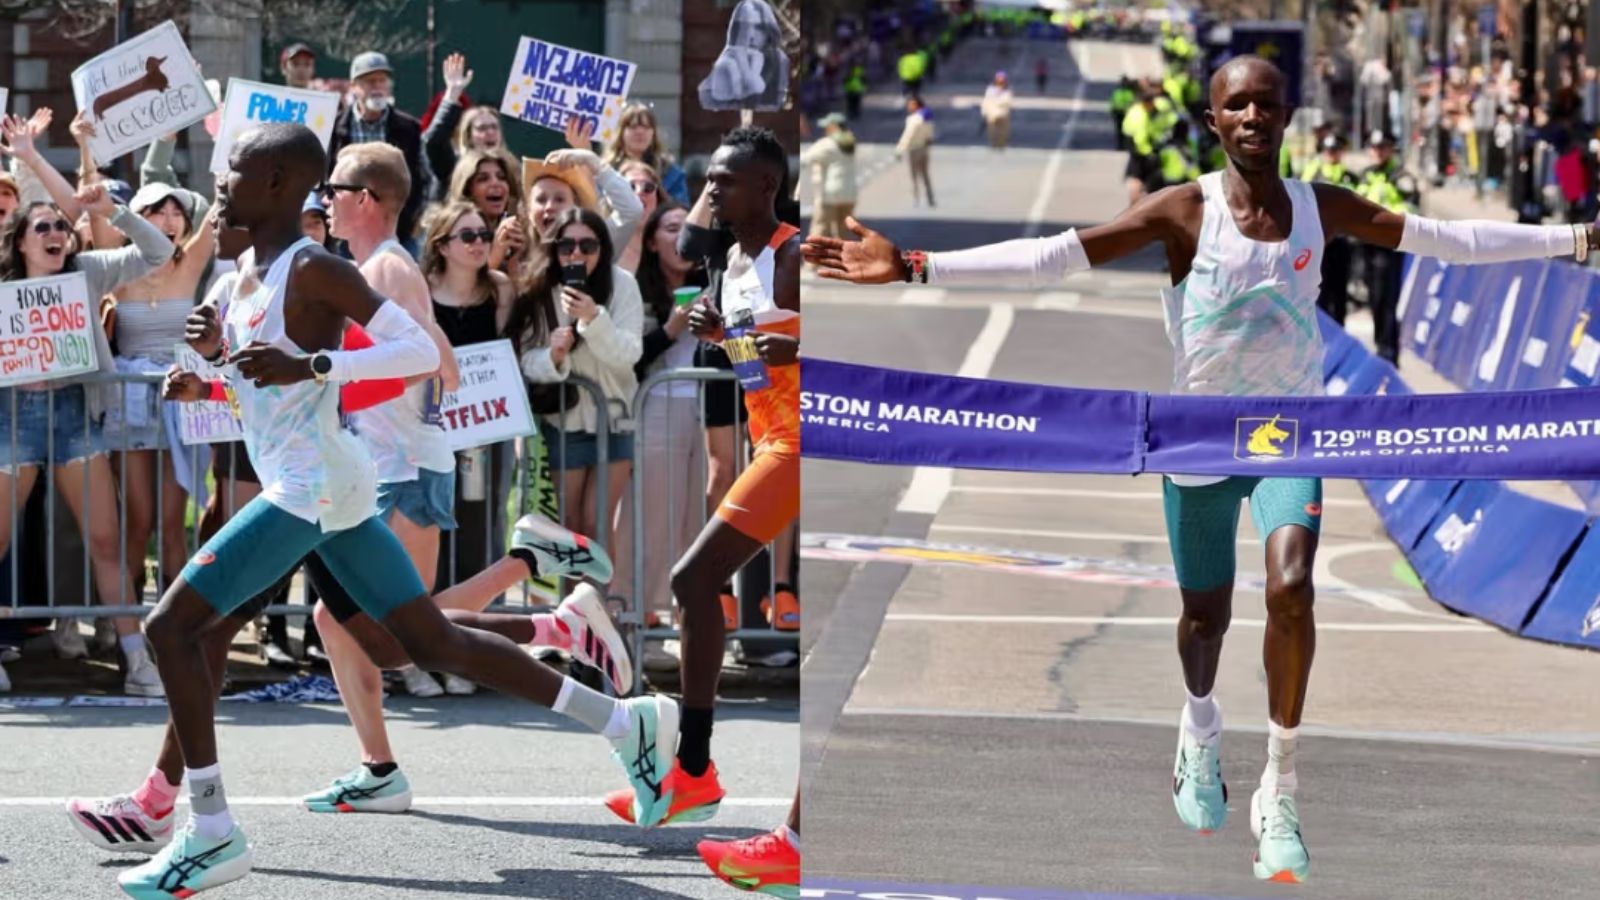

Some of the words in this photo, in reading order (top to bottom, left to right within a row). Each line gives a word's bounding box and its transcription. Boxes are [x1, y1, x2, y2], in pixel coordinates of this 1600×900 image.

[522, 40, 629, 95] EUROPEAN
[247, 92, 308, 125] POWER
[575, 92, 606, 115] FOR
[878, 402, 1037, 432] MARATHON
[1312, 429, 1371, 448] 129TH
[1376, 425, 1488, 446] BOSTON
[1313, 449, 1371, 458] BANK
[1378, 448, 1405, 456] OF
[1410, 444, 1509, 456] AMERICA
